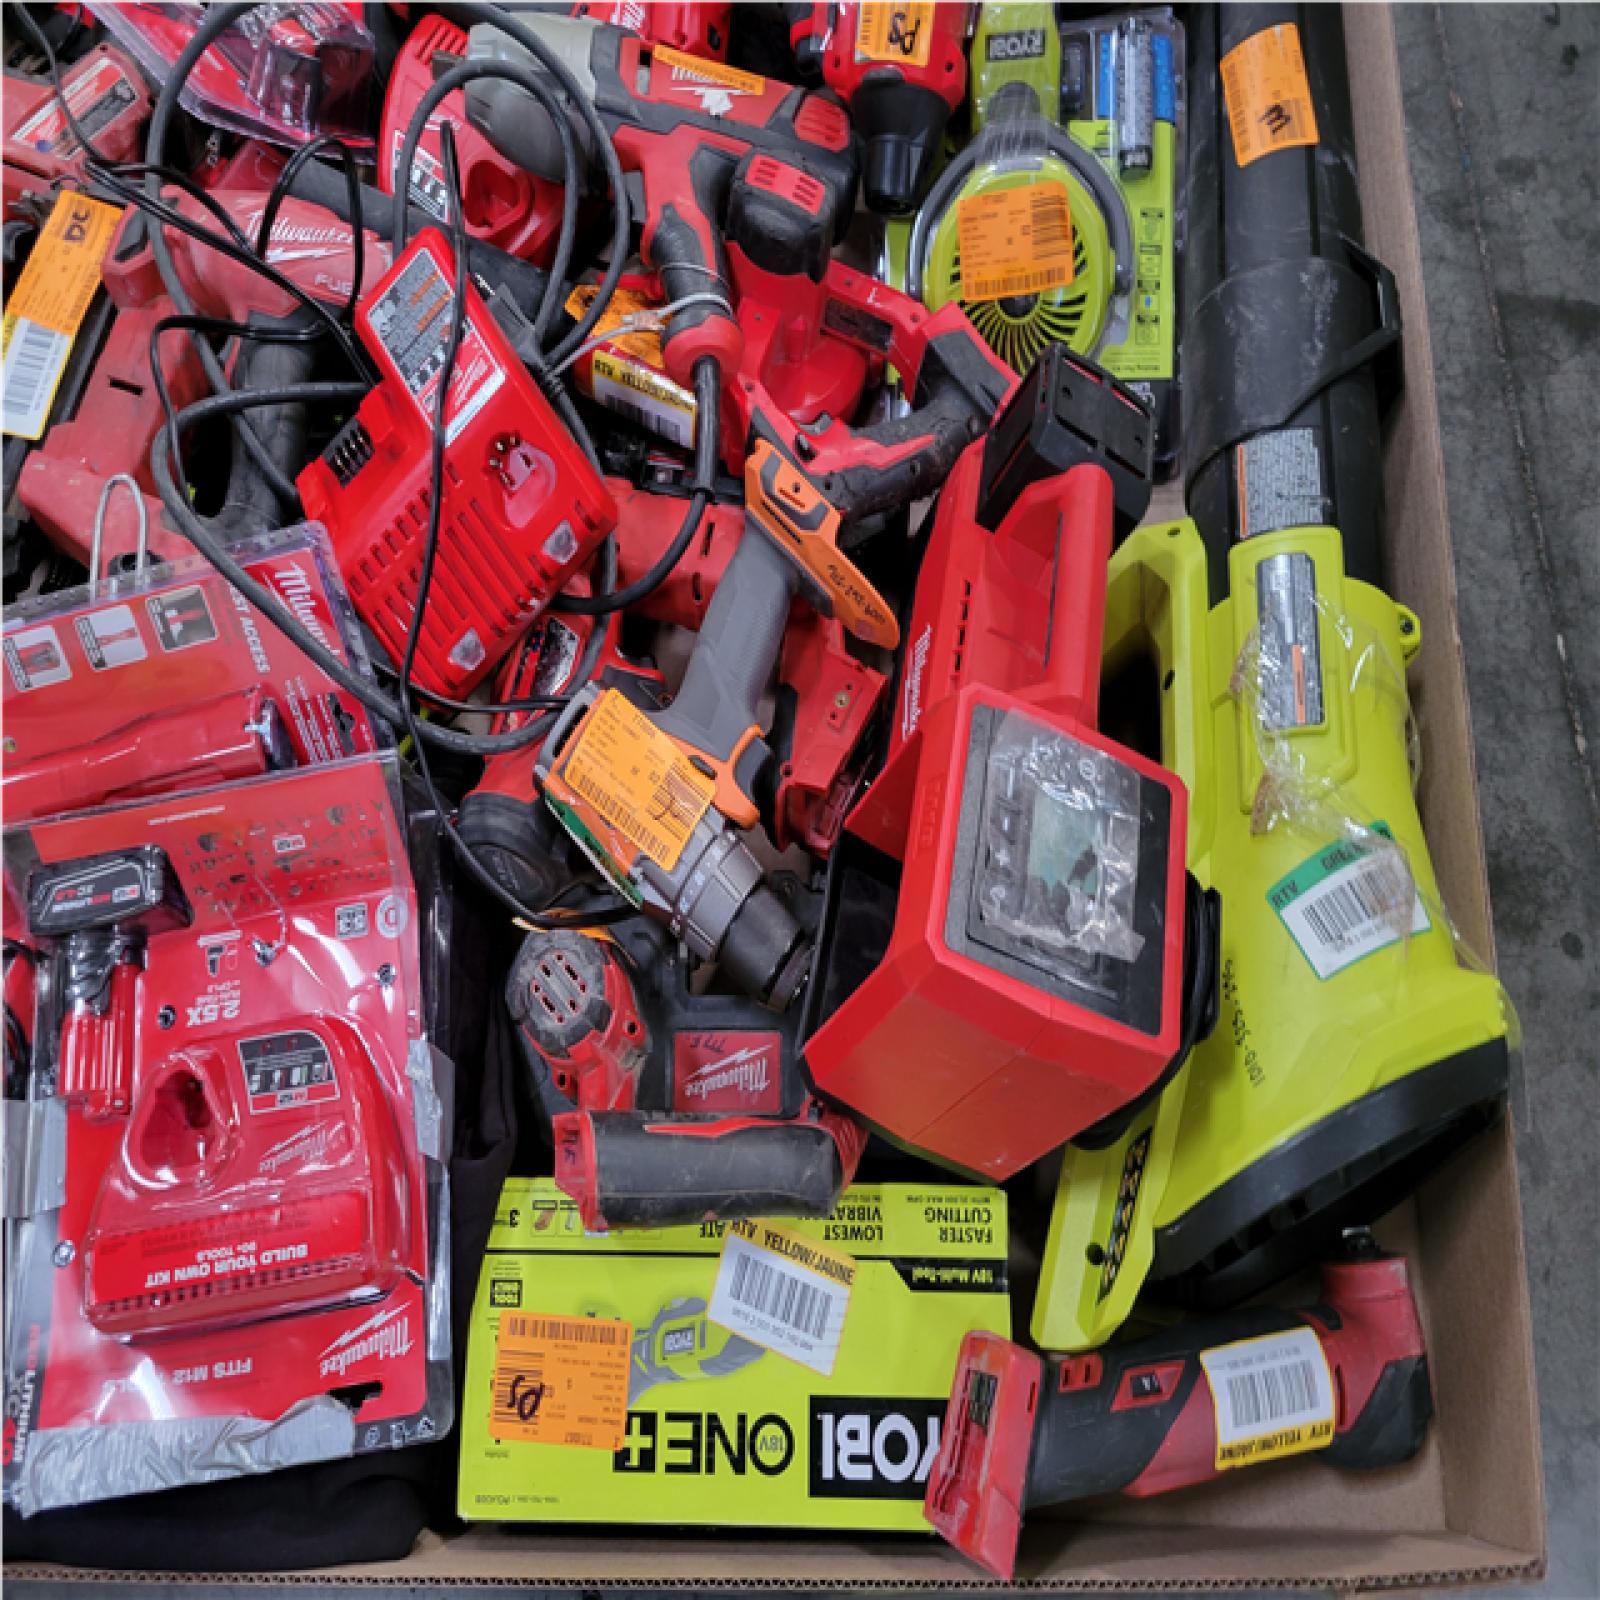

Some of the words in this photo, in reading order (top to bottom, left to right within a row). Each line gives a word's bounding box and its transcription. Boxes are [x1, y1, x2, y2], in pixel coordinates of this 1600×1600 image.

[988, 32, 1047, 57] RYOBI
[240, 617, 271, 673] ACCESS
[684, 1055, 770, 1098] Milwaukee
[509, 1208, 521, 1228] 3
[924, 1207, 992, 1225] CUTTING
[825, 1224, 883, 1241] LOWEST
[939, 1227, 993, 1244] FASTER
[145, 1269, 170, 1288] KIT
[174, 1263, 211, 1281] OWN
[214, 1254, 257, 1274] YOUR
[260, 1243, 308, 1265] BUILD
[196, 1247, 234, 1262] TOOLS
[320, 1317, 415, 1376] Milwaukee
[213, 1357, 254, 1379] FITS
[613, 1411, 795, 1476] ONE+
[817, 1413, 941, 1483] YOBI
[757, 1434, 787, 1453] 18V
